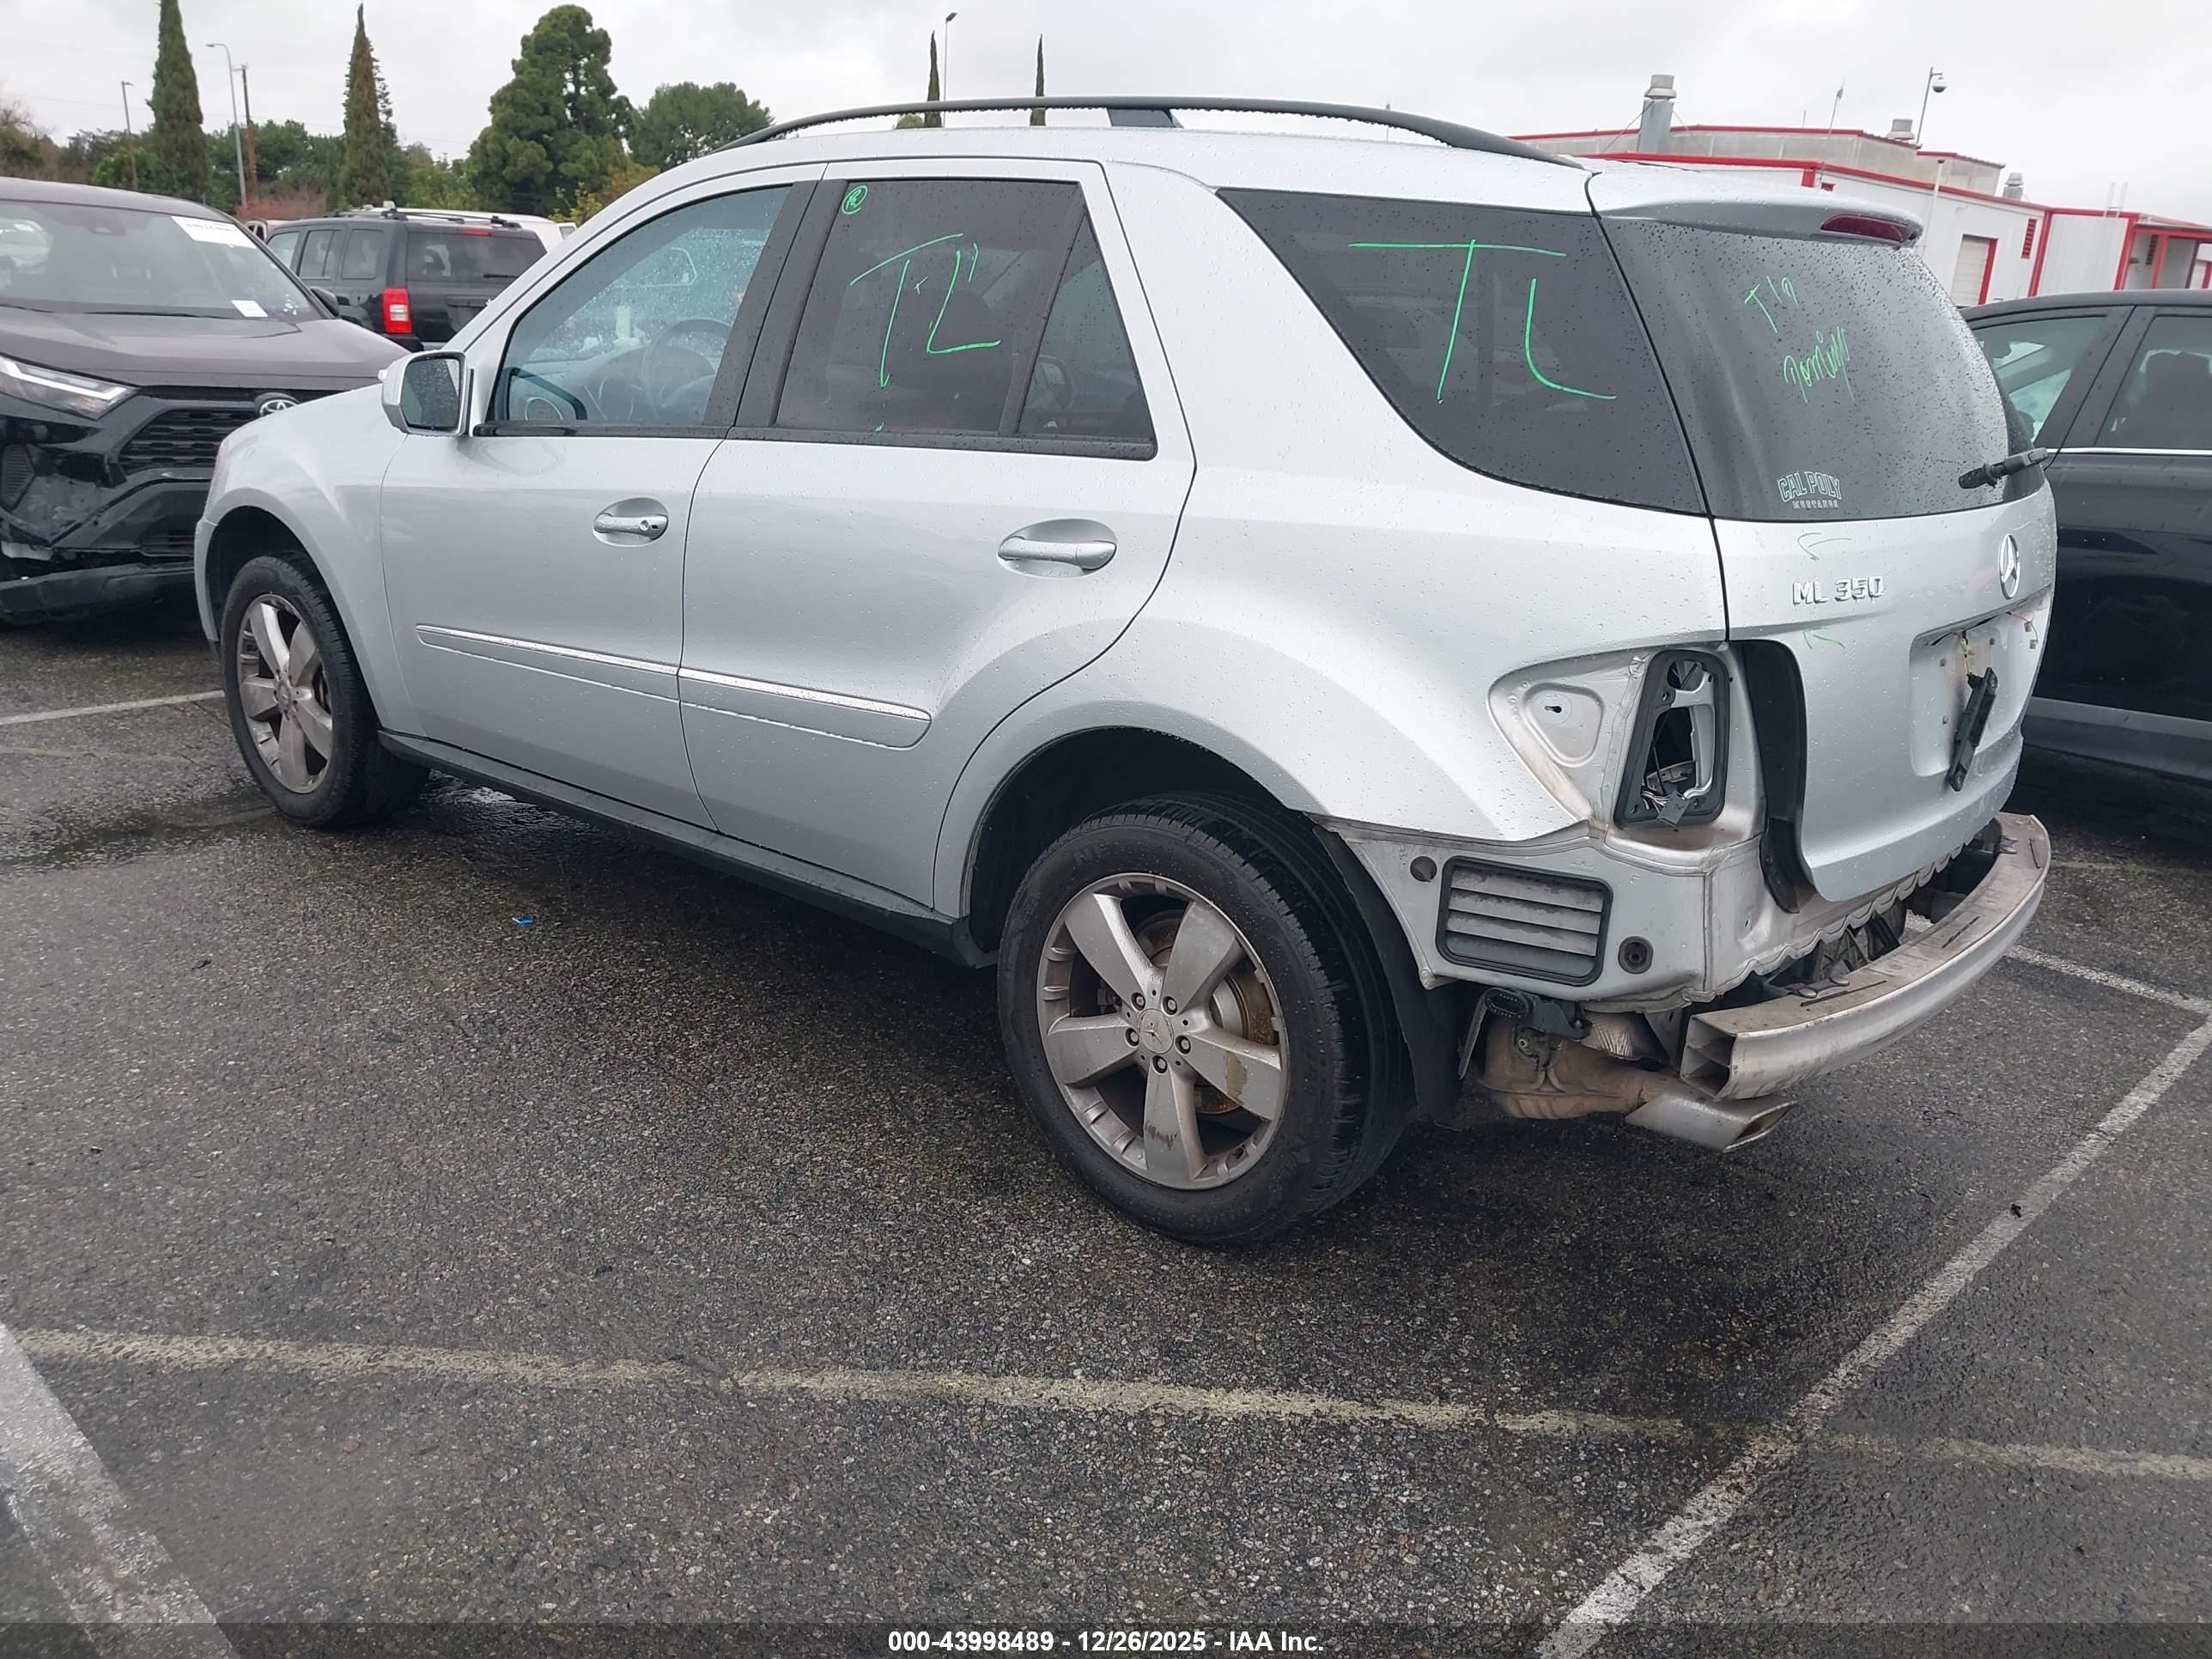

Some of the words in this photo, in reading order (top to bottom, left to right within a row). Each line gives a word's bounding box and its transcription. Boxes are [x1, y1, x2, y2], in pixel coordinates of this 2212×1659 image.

[1778, 471, 1808, 502] CAL
[1804, 471, 1842, 500] POLY
[1793, 580, 1829, 605] ML
[1834, 575, 1884, 603] 350
